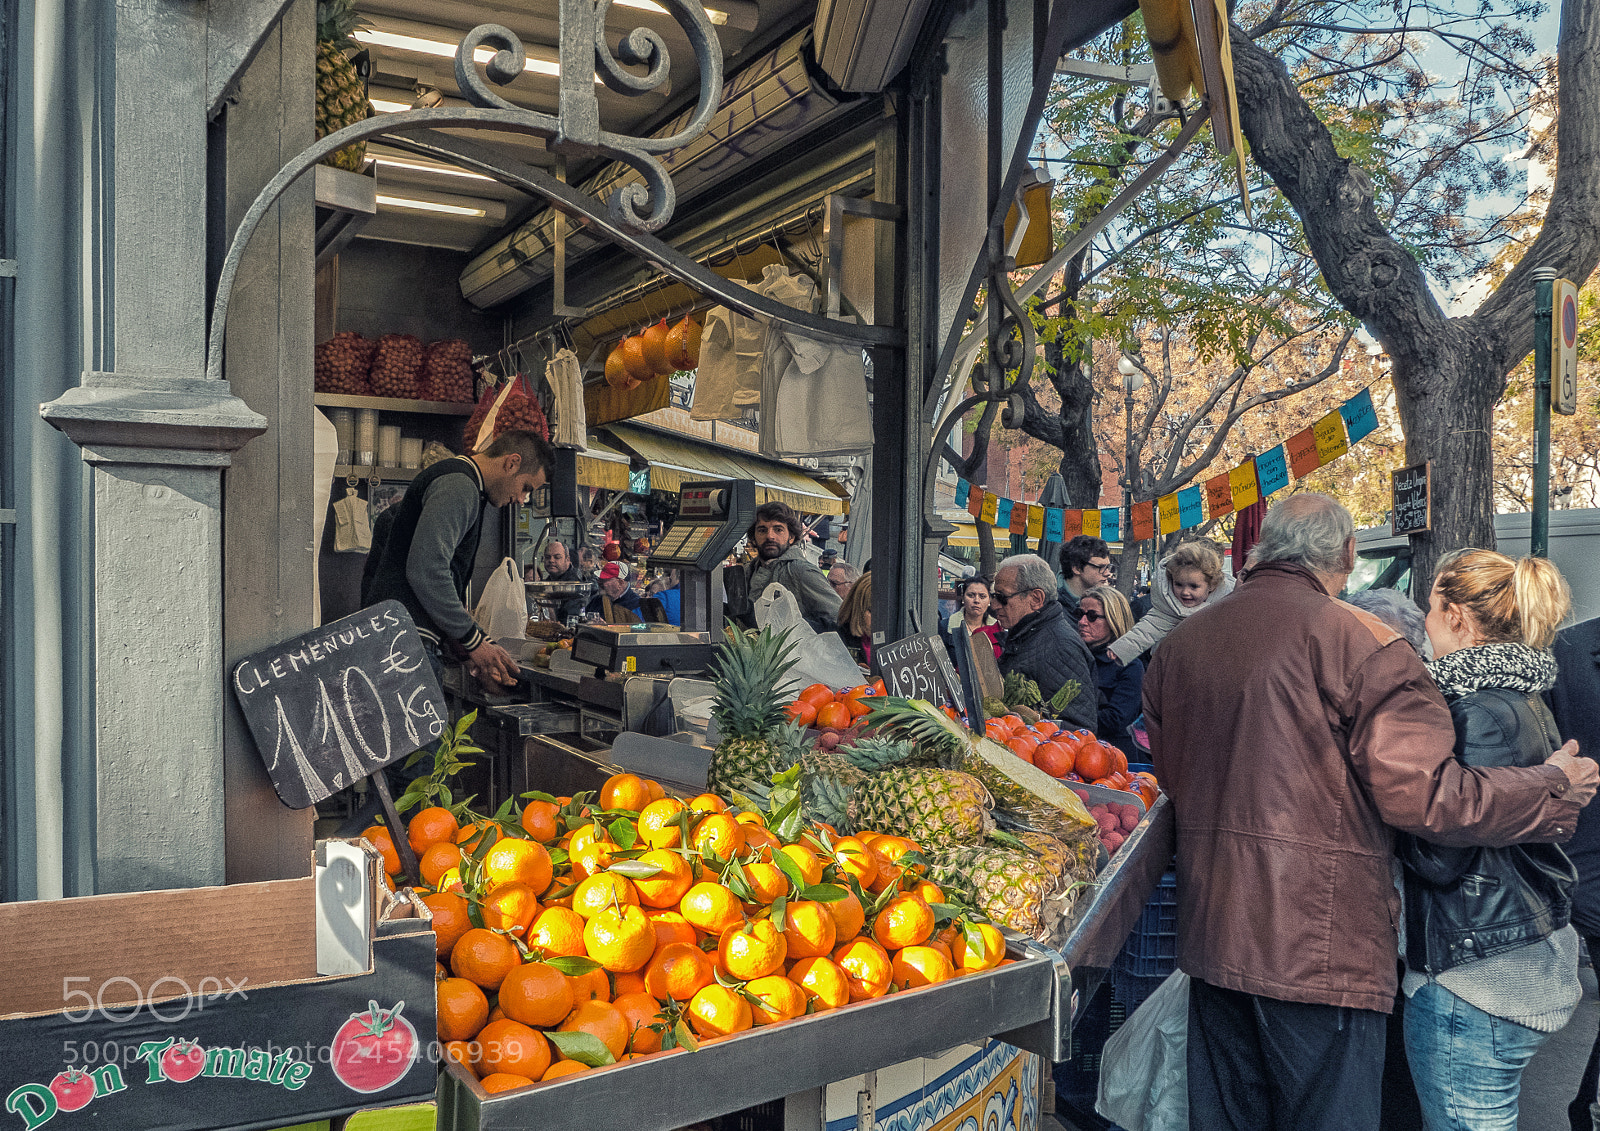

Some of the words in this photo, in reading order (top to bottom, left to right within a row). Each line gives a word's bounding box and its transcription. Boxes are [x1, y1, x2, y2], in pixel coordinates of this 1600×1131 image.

[235, 609, 400, 694] CLEMENULES
[380, 629, 424, 674] €
[136, 1036, 313, 1091] Tomate
